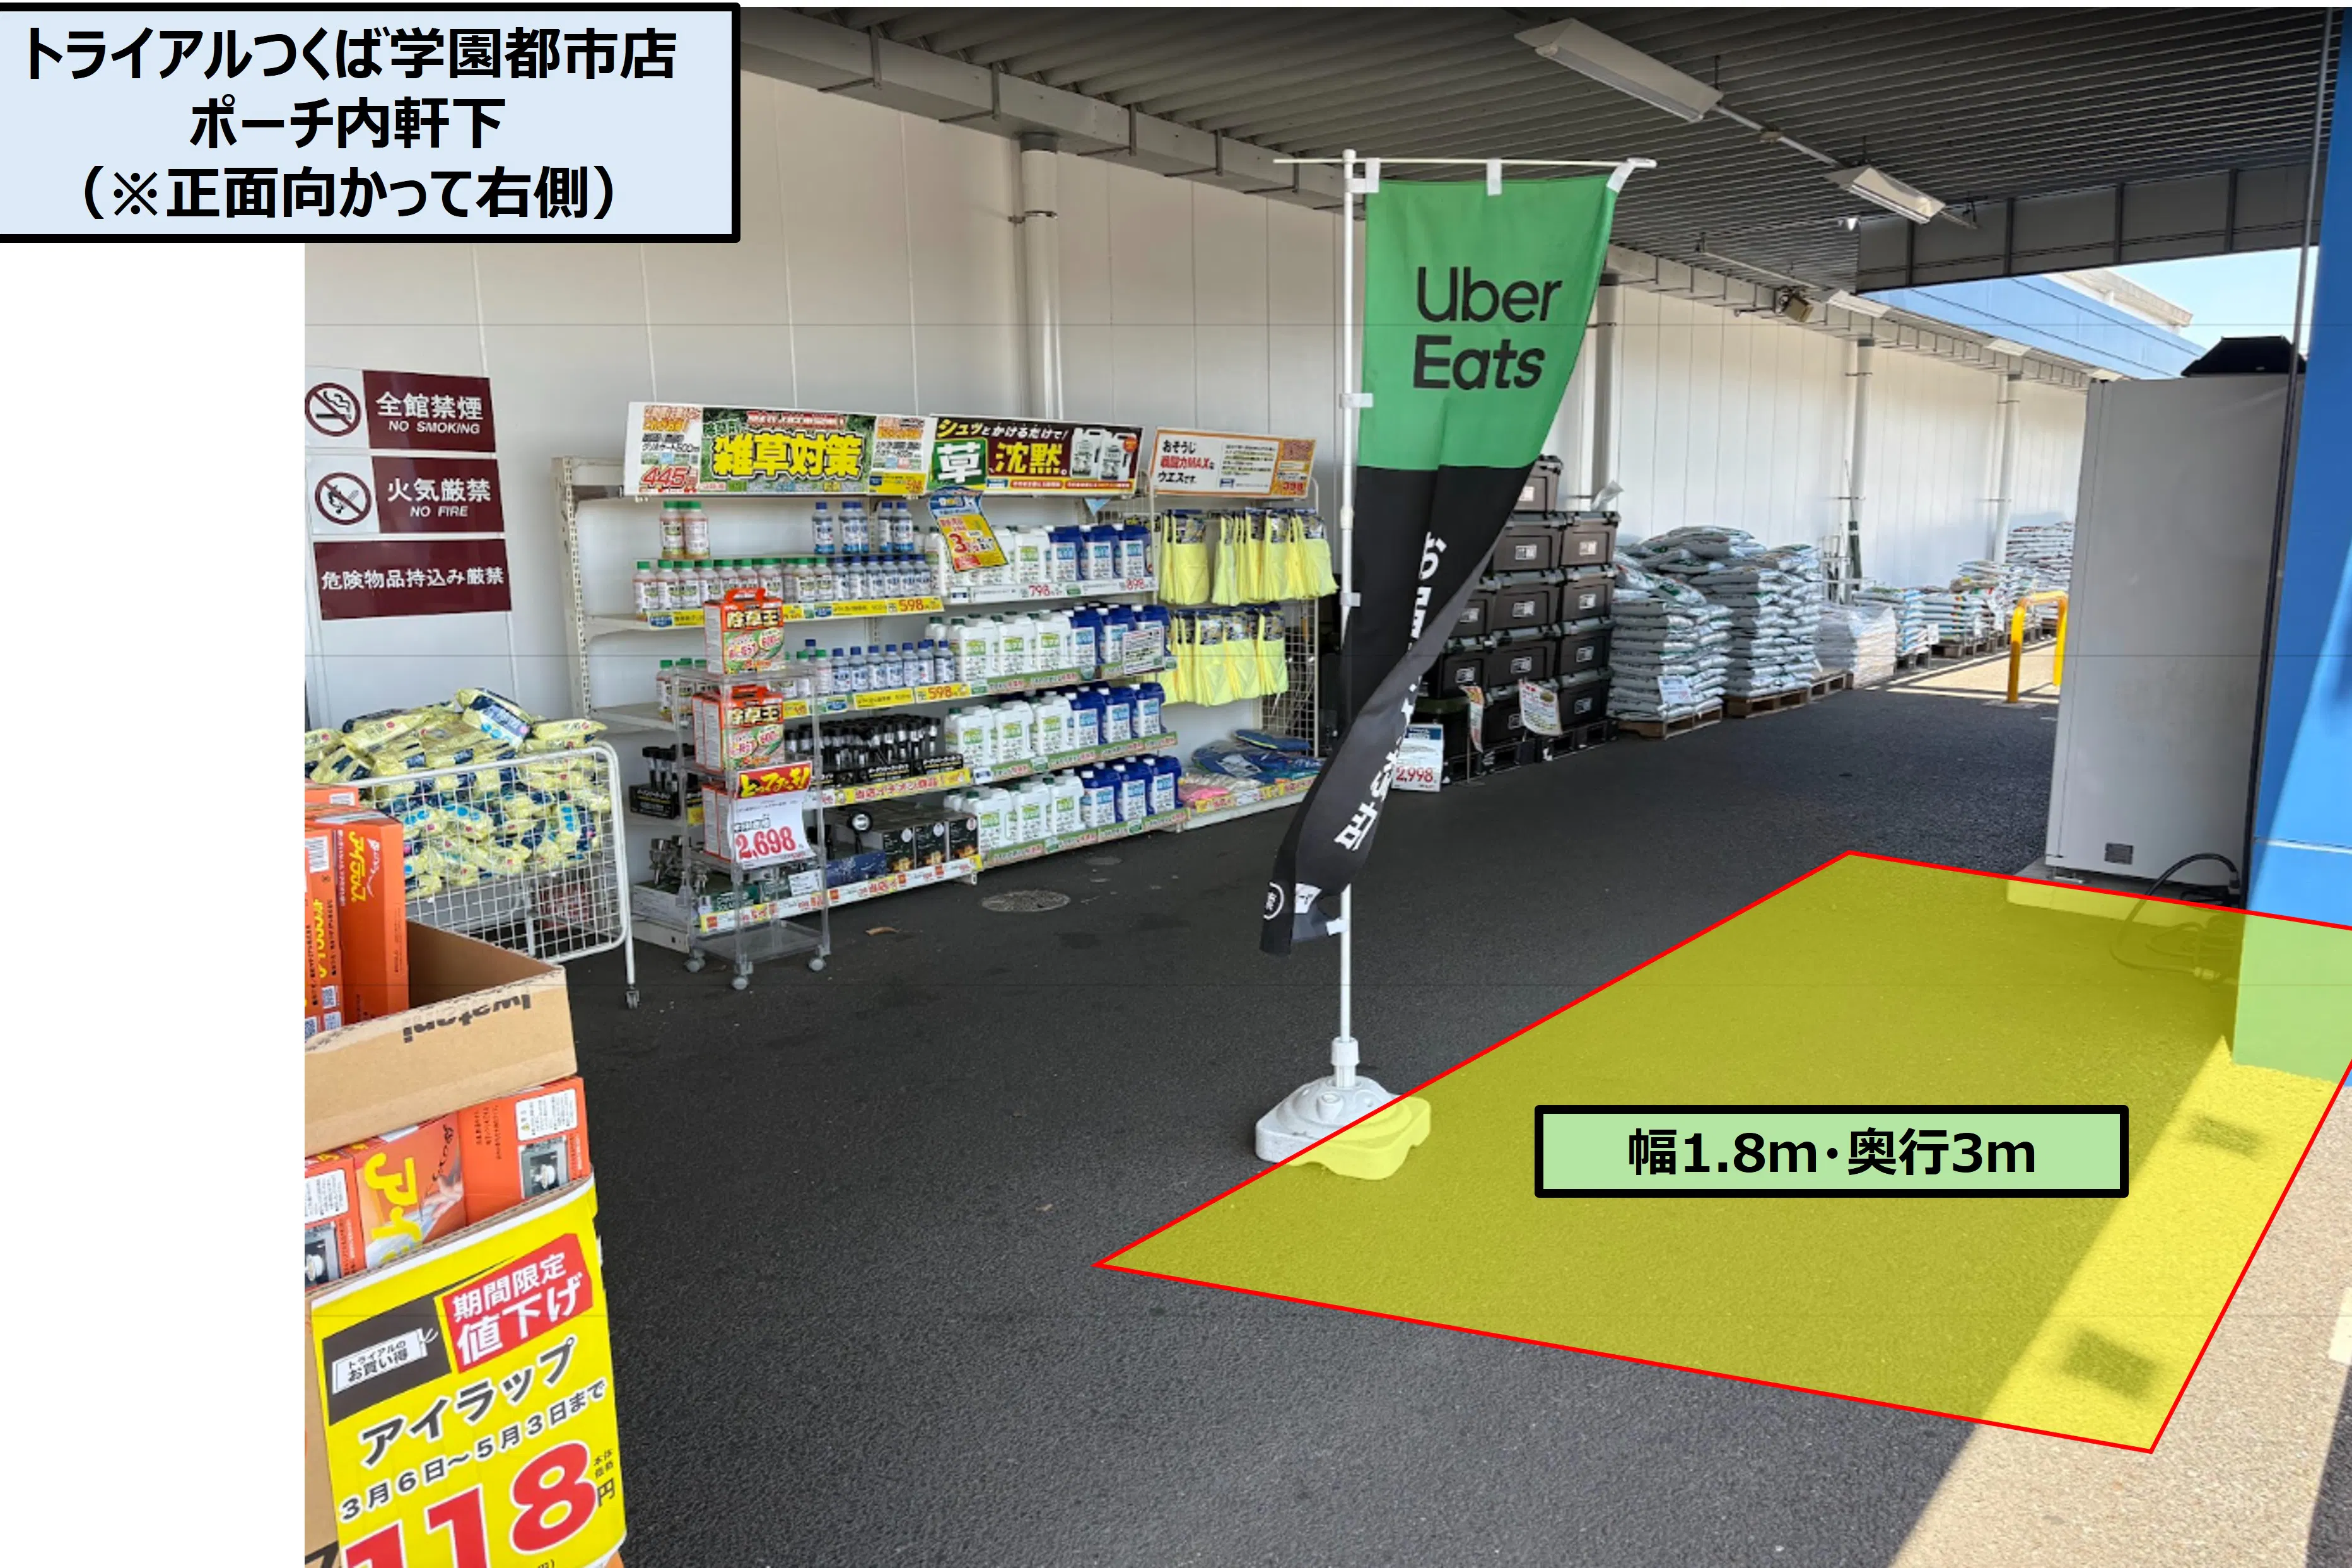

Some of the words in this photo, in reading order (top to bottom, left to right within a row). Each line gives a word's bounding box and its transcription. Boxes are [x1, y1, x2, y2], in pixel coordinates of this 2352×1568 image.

[1417, 266, 1563, 323] Uber
[1413, 334, 1546, 390] Eats
[375, 391, 484, 421] 全館禁煙
[388, 419, 409, 432] NO
[416, 421, 481, 435] SMOKING
[713, 431, 863, 476] 雑草対策
[1162, 440, 1196, 454] おそうじ
[387, 477, 491, 503] 火気厳禁
[641, 465, 687, 486] 445
[410, 505, 431, 517] NO
[438, 506, 468, 517] FIRE
[320, 566, 504, 591] 危険物品持込み厳禁
[1029, 584, 1051, 597] 798
[898, 599, 924, 612] 598
[928, 686, 952, 700] 598
[1395, 766, 1434, 783] 2,998
[735, 825, 797, 859] 2,698
[402, 994, 532, 1044] Iwatani
[452, 1251, 567, 1322] 期間限定
[456, 1272, 583, 1367] 値下げ
[348, 1348, 409, 1383] お買い得
[349, 1340, 406, 1369] トライアルの
[362, 1336, 575, 1466] アイラップ
[597, 1478, 616, 1508] 円
